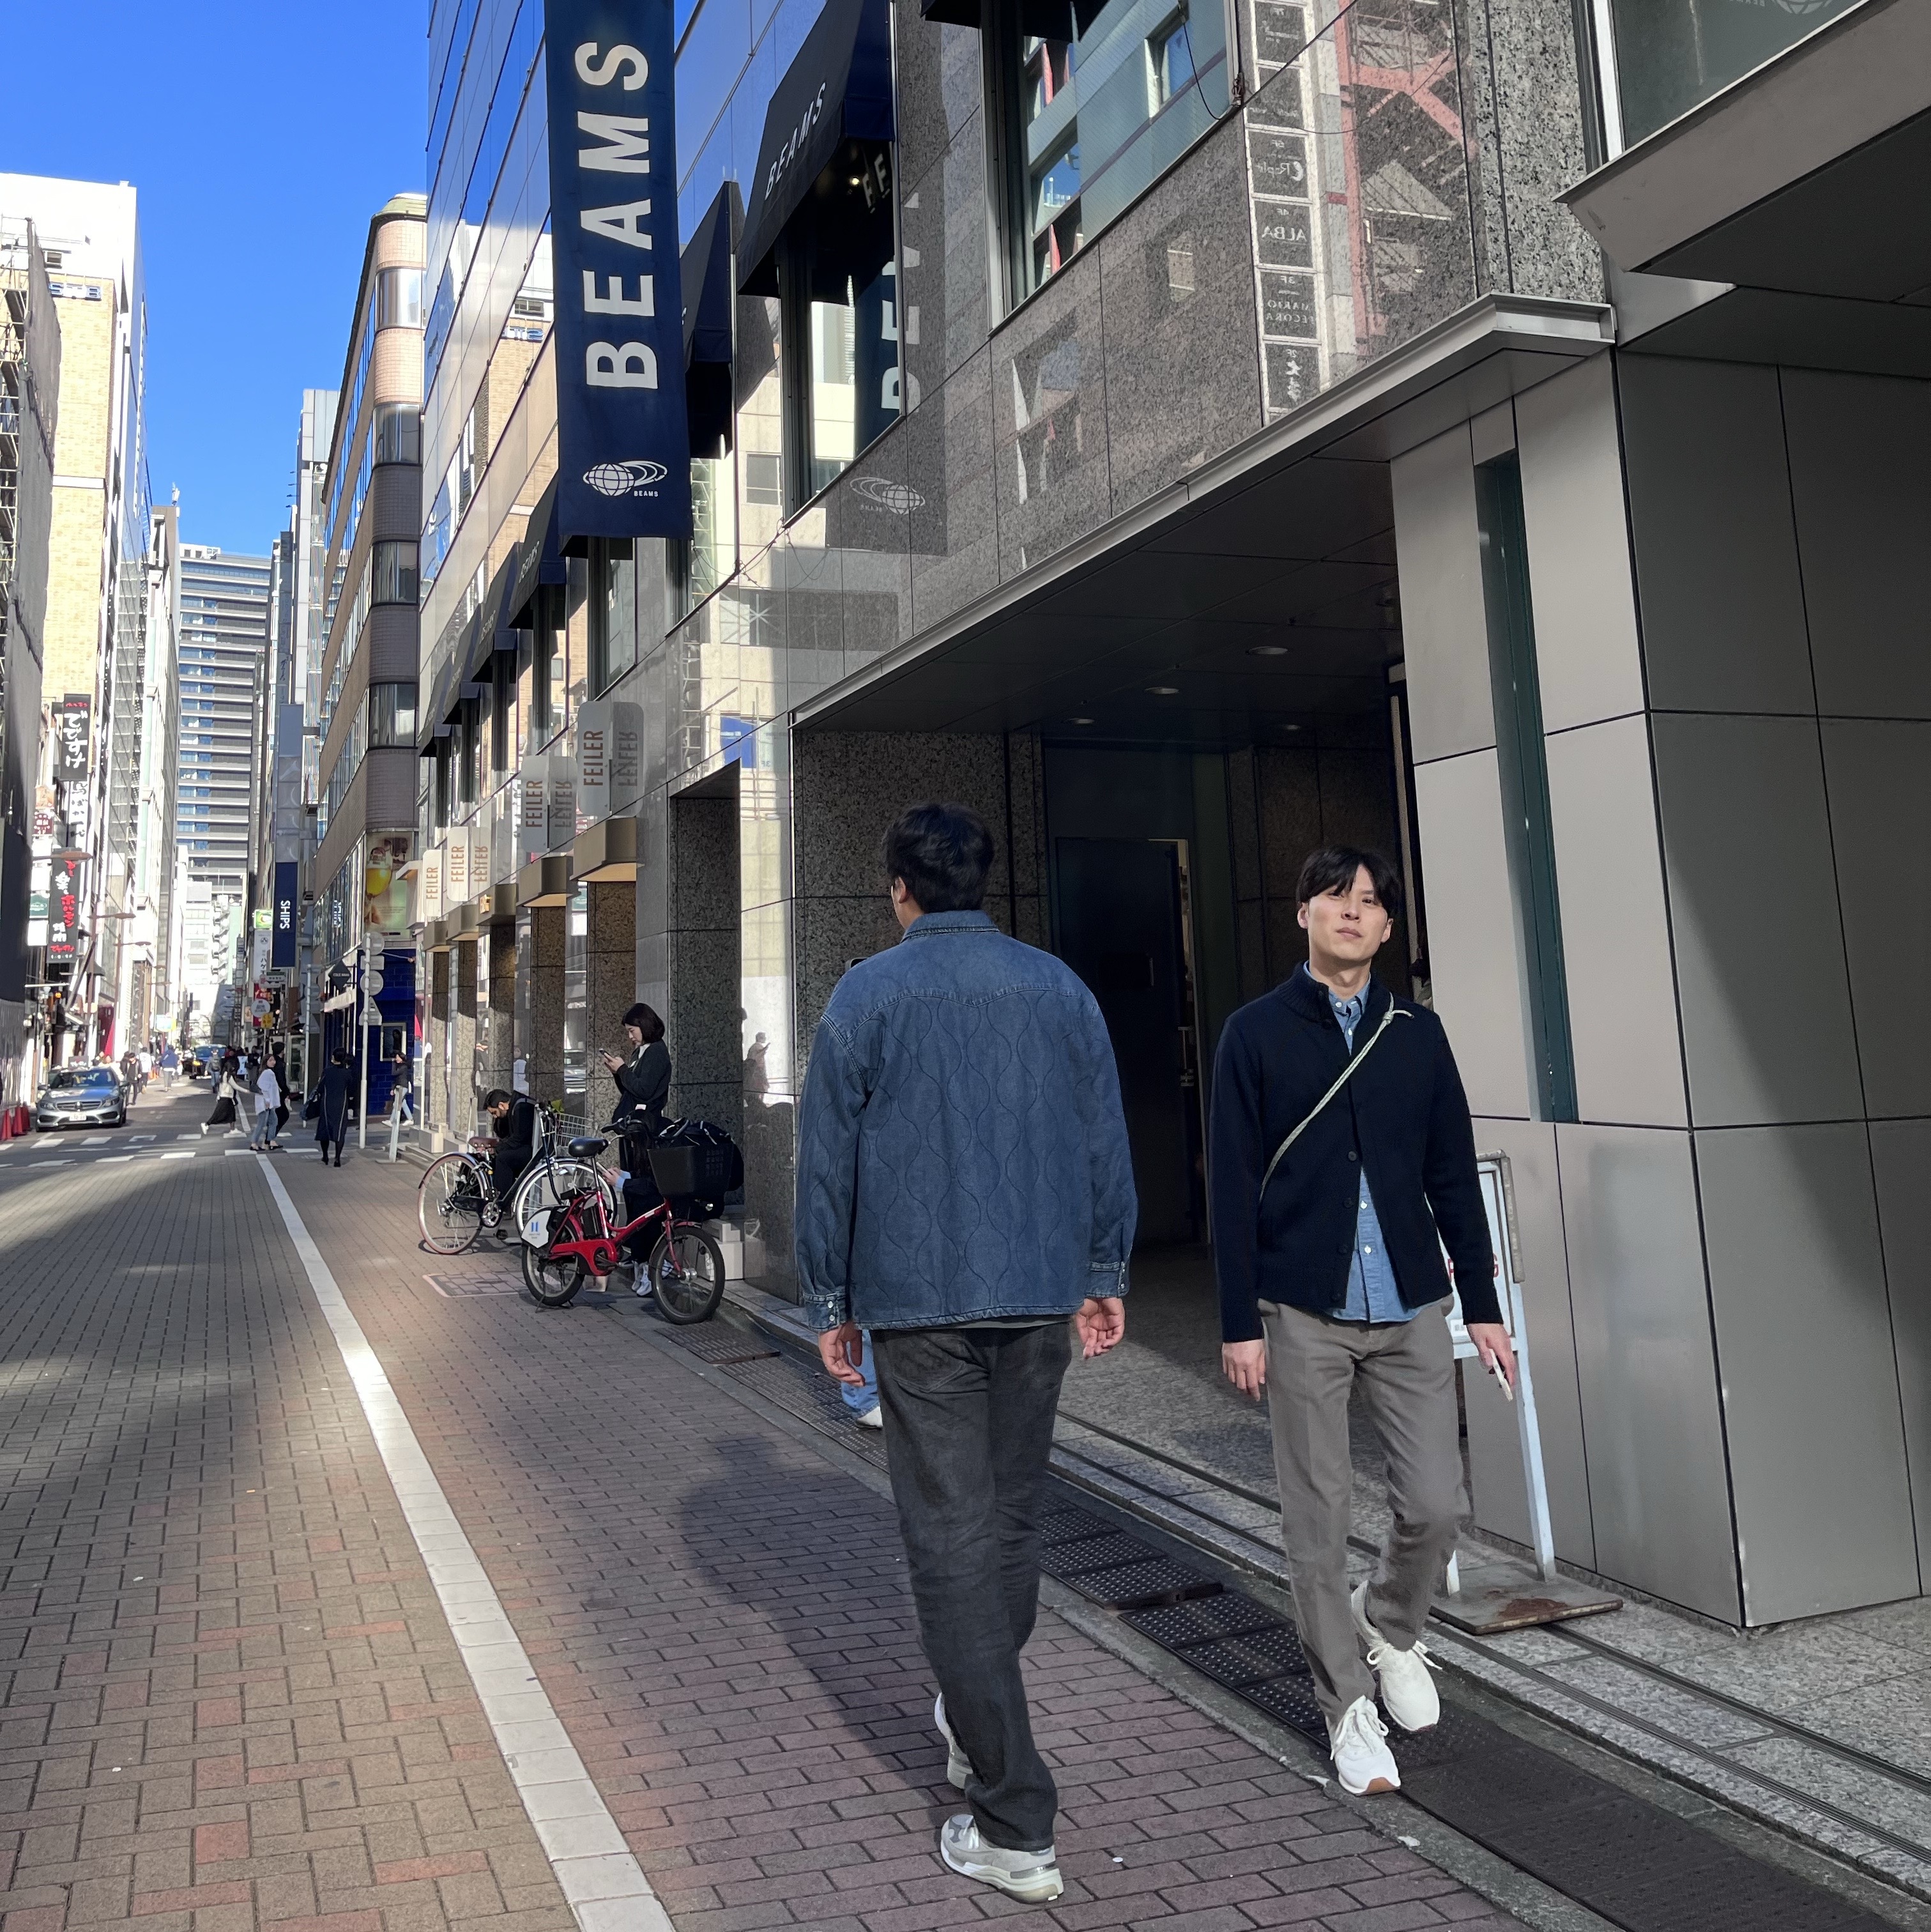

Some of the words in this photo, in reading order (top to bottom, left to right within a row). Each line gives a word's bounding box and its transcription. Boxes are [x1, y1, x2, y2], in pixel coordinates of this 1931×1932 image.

[765, 81, 826, 201] BEAMS
[574, 41, 659, 390] BEAMS
[583, 730, 604, 786] FEILER
[526, 780, 543, 827] FEILER
[425, 866, 438, 900] FEILER
[451, 845, 464, 882] FEILER
[280, 900, 291, 930] SHIPS
